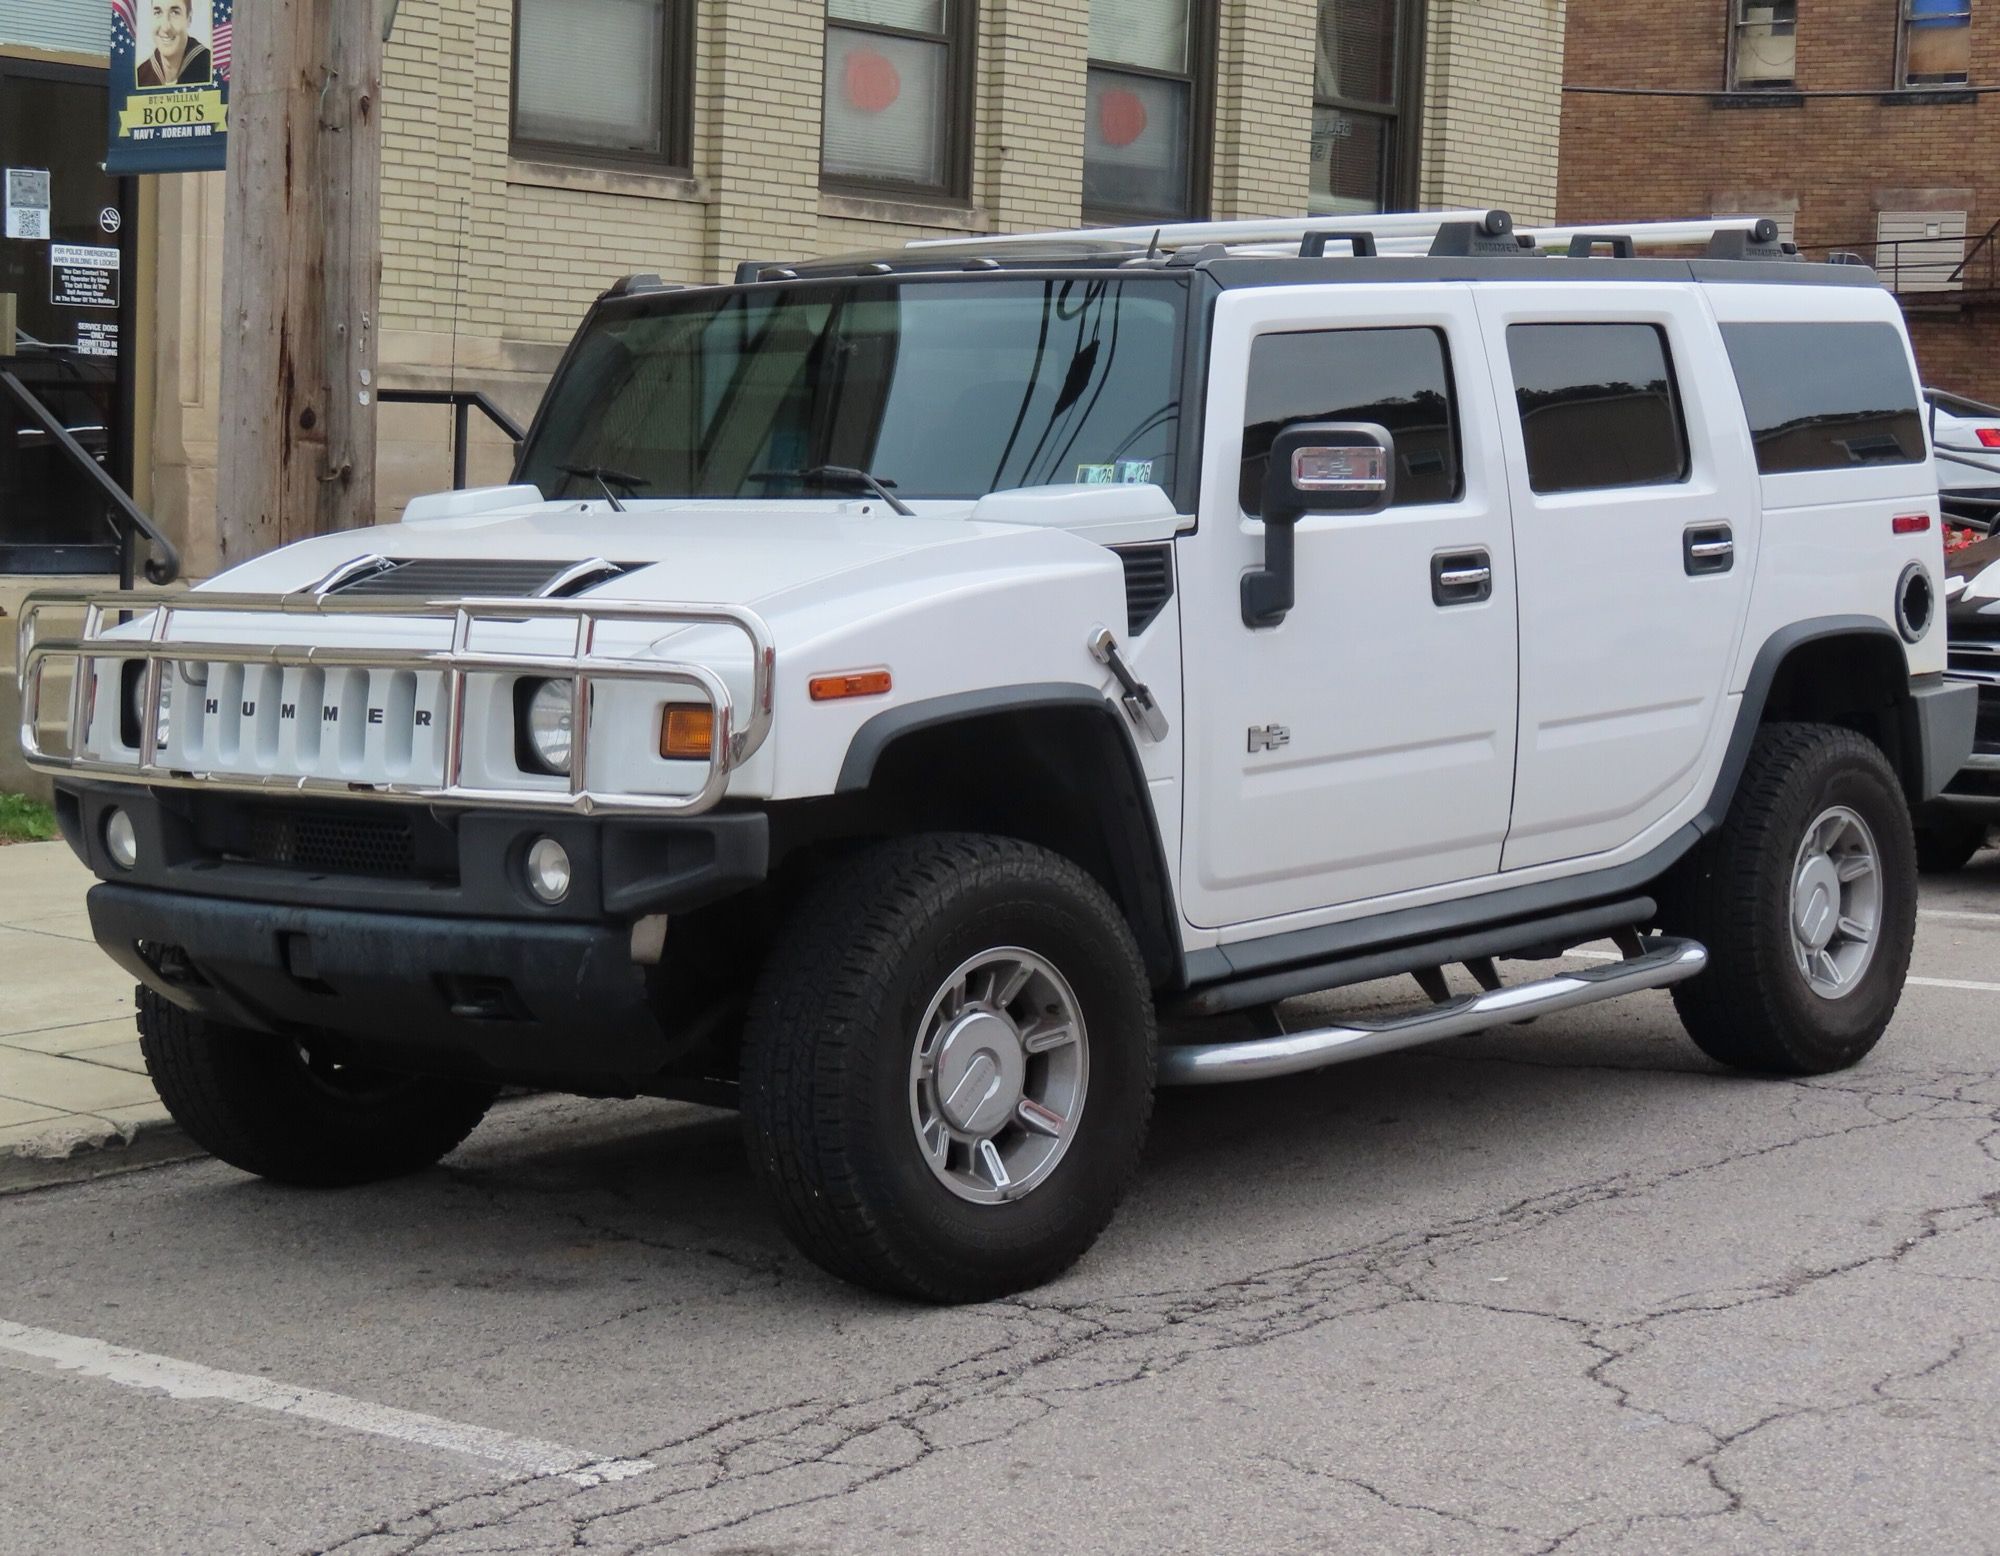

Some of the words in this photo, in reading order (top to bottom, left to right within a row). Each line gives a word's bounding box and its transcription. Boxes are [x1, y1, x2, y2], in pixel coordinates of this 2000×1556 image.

[166, 94, 200, 102] WILLIAM
[143, 104, 204, 124] BOOTS
[133, 128, 154, 140] NAVY
[162, 126, 192, 138] KOREAN
[194, 125, 212, 136] WAR
[66, 248, 83, 256] POLICE
[84, 250, 118, 258] EMERGENCIES
[97, 277, 110, 285] Using
[98, 298, 116, 306] Building
[78, 322, 102, 331] SERVICE
[102, 324, 118, 332] DOGS
[90, 332, 105, 340] ONLY
[78, 338, 110, 348] PERMITTED
[78, 346, 91, 354] THIS
[92, 348, 118, 356] BUILDING
[206, 698, 432, 726] HUMMER
[1247, 723, 1290, 752] H2
